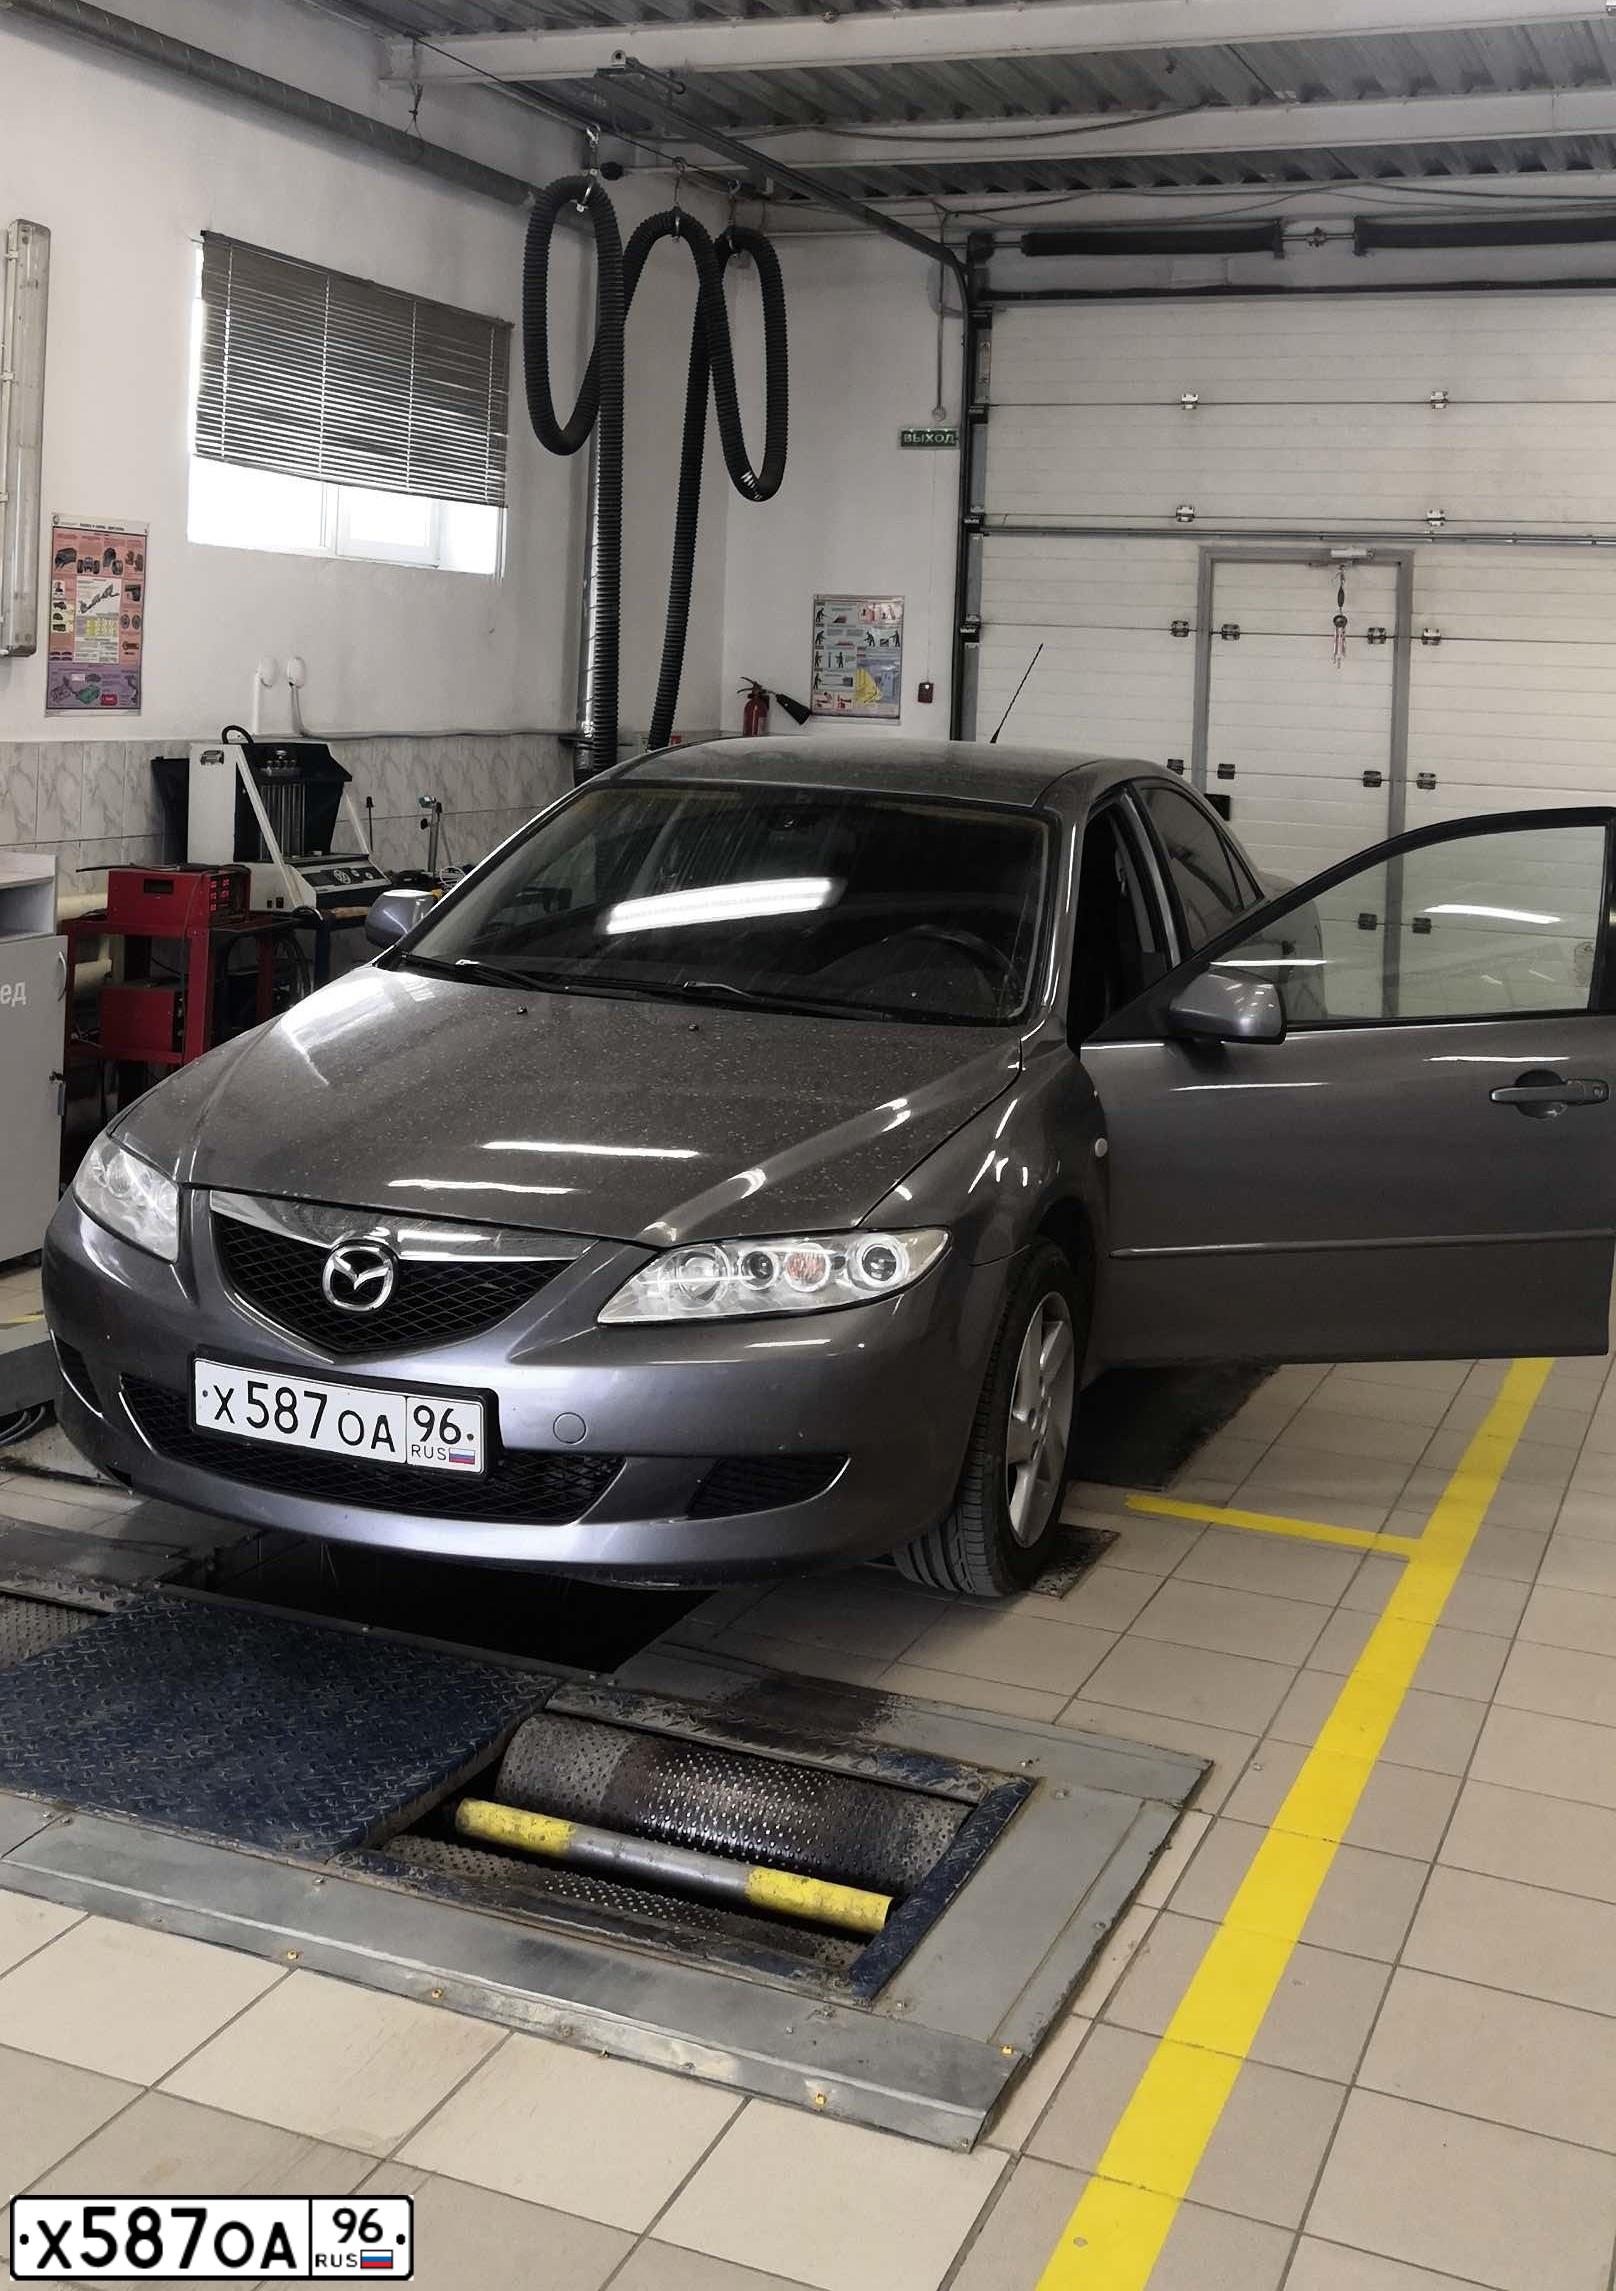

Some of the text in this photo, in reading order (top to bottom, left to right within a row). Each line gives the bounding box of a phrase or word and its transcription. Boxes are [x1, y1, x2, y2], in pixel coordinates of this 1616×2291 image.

[903, 433, 954, 444] ВЫХОД
[413, 1404, 462, 1445] 96
[410, 1444, 447, 1461] RUS
